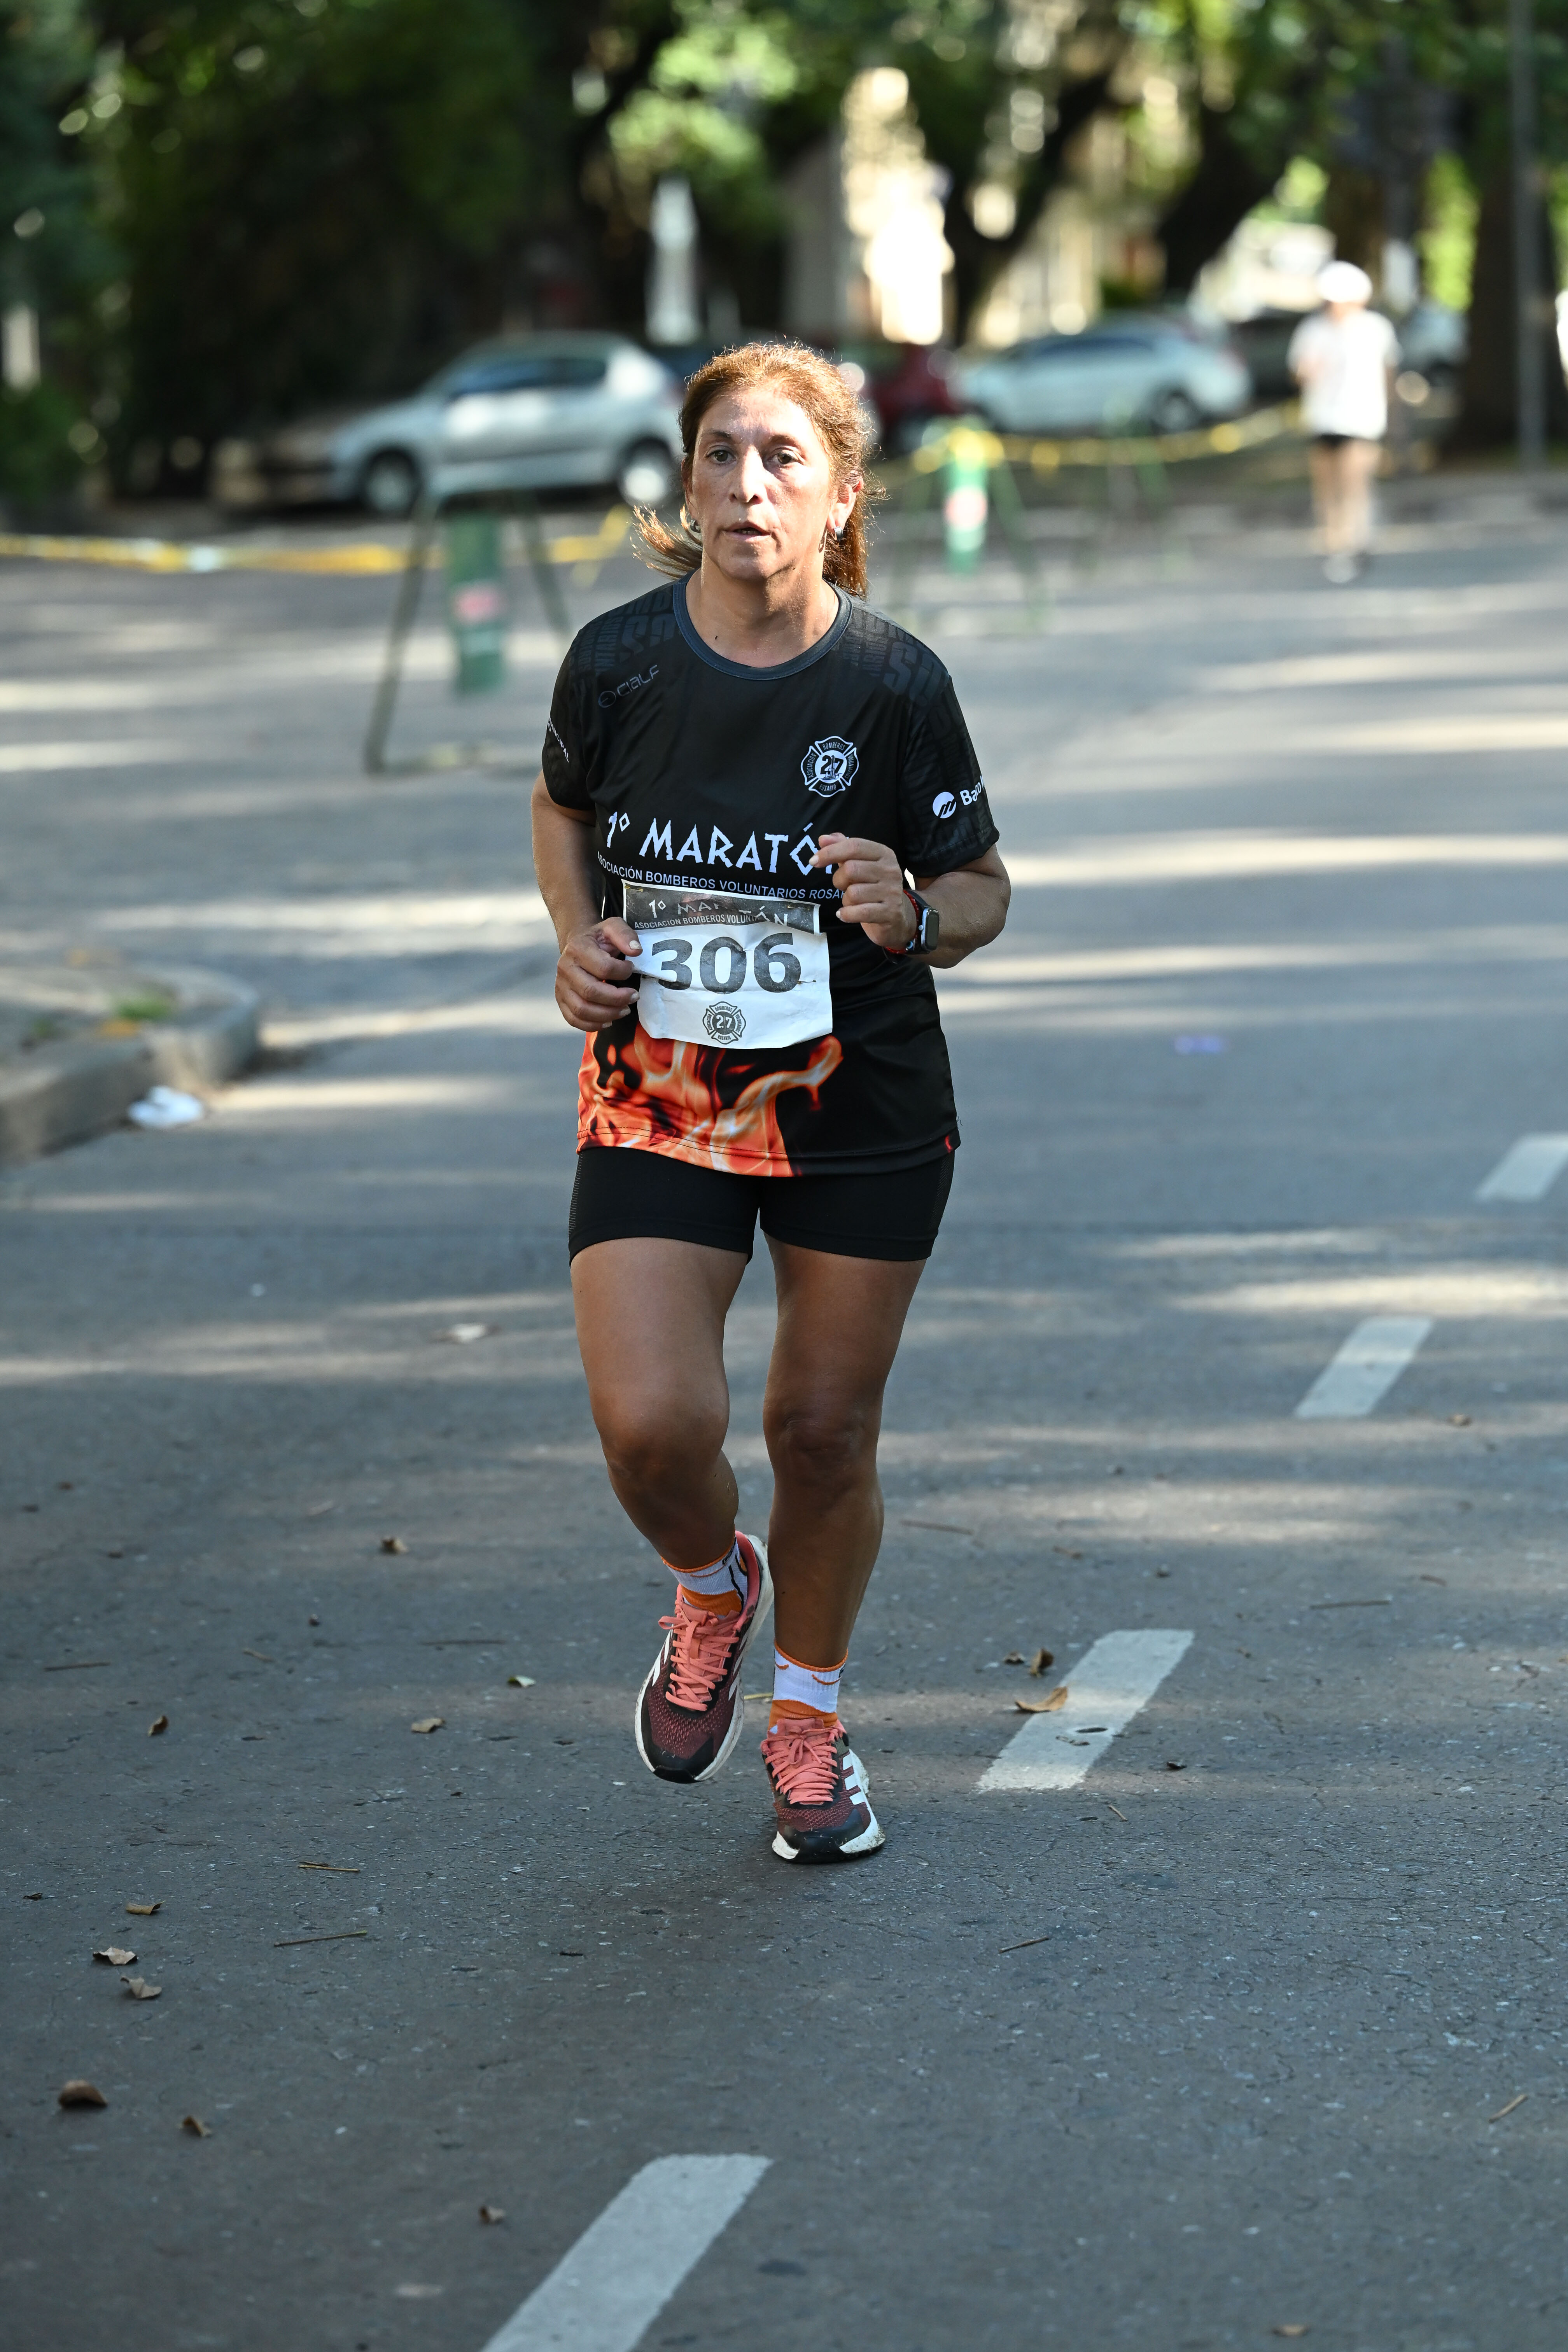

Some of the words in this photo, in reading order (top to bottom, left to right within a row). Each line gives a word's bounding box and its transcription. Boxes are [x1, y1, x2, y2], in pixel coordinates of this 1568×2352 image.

[822, 742, 845, 751] BOMBEROS
[820, 755, 844, 775] 27
[639, 818, 832, 875] MARATÓ
[597, 851, 642, 880] ASOCIACIÓN
[646, 871, 715, 889] BOMBEROS
[719, 880, 806, 898] VOLUNTARIOS
[635, 918, 681, 929] ASOCIACIÓN
[682, 914, 725, 924] BOMBEROS
[651, 932, 801, 994] 306
[716, 1015, 732, 1029] 27
